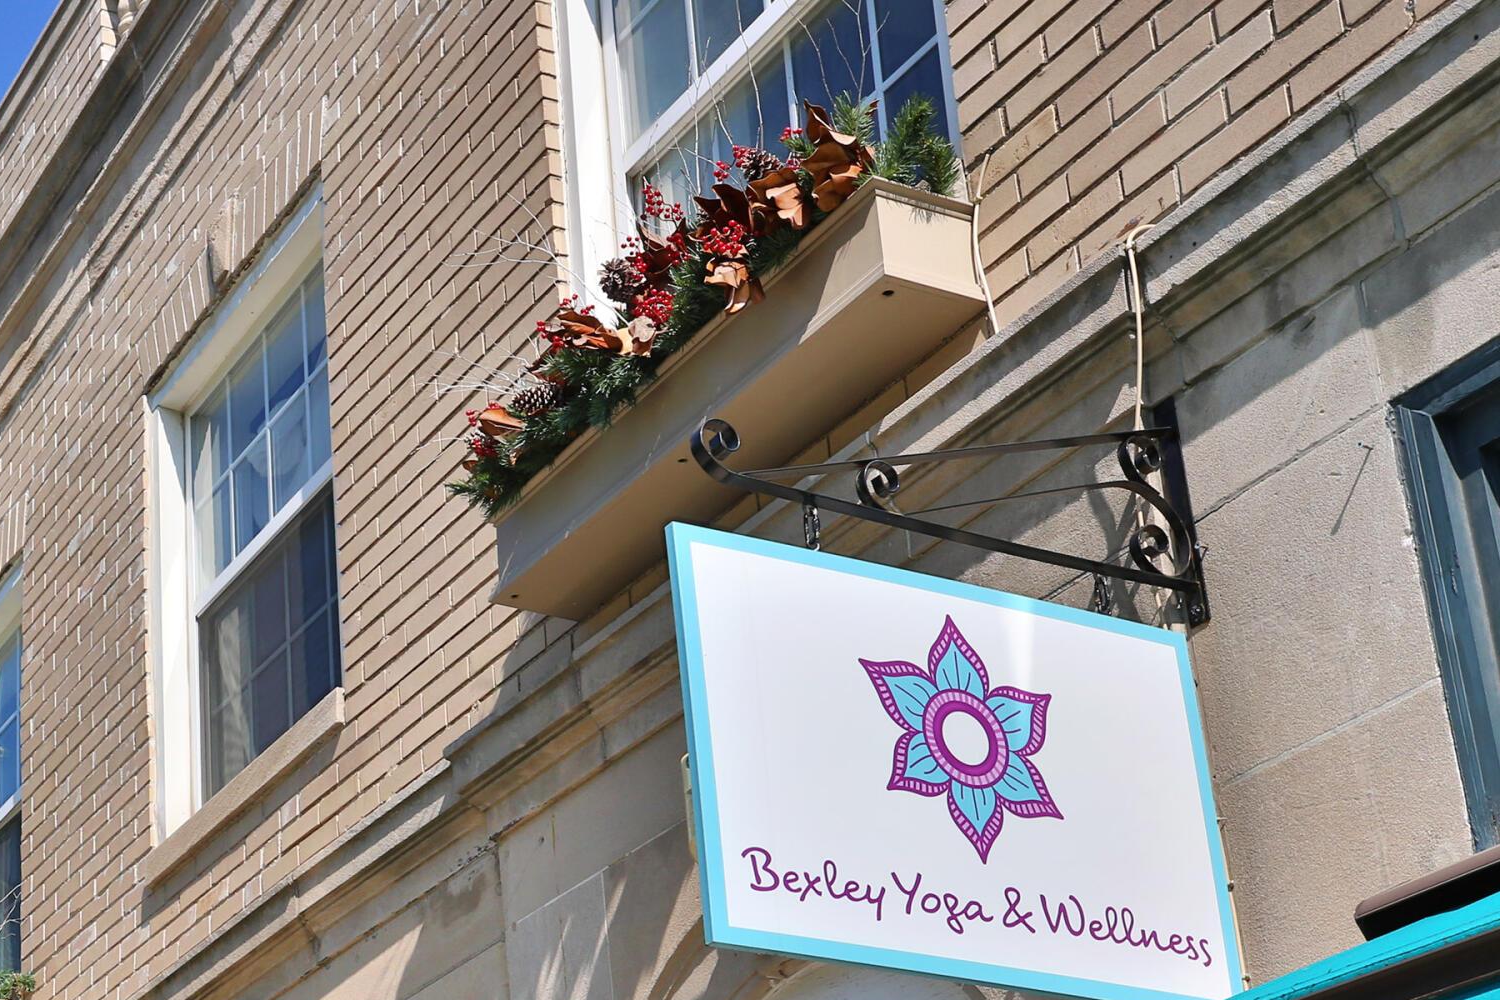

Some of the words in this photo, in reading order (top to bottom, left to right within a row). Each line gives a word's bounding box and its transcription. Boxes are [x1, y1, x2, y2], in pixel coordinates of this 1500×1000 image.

[741, 846, 887, 921] Bexley
[890, 871, 994, 935] Yoga
[1002, 886, 1036, 934] &
[1039, 893, 1214, 968] Wellness
